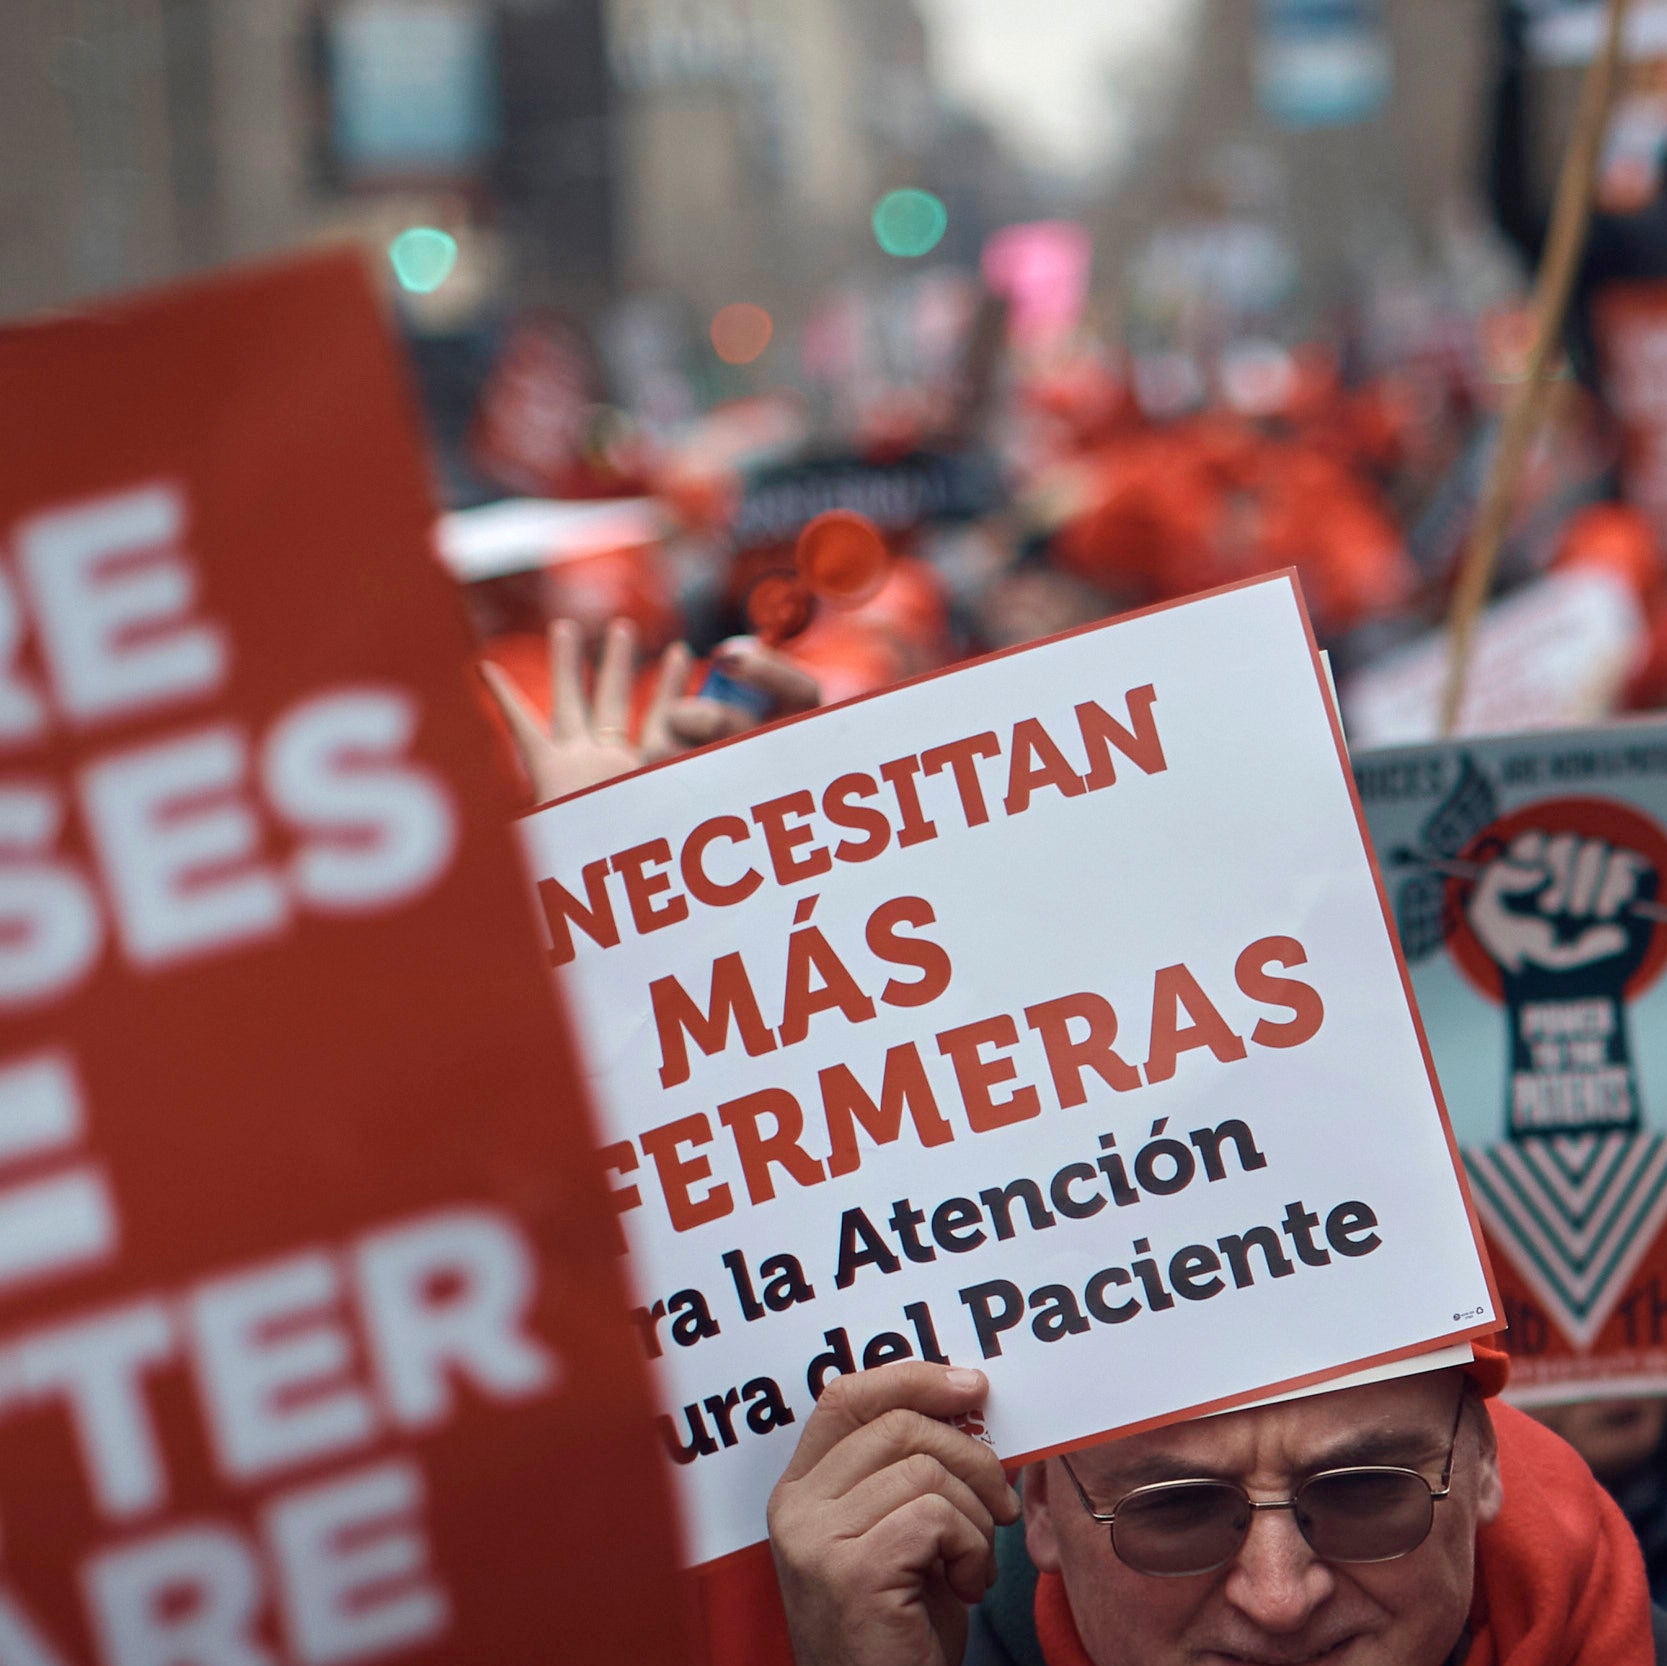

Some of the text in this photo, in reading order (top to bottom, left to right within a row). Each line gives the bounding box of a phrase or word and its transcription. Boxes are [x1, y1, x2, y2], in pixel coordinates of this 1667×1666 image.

[537, 683, 1169, 968] NECESITAN
[649, 894, 953, 1090] MÁS
[723, 1249, 816, 1321] la
[834, 1116, 1268, 1290] Atención
[805, 1300, 951, 1403] del
[959, 1198, 1384, 1361] Paciente
